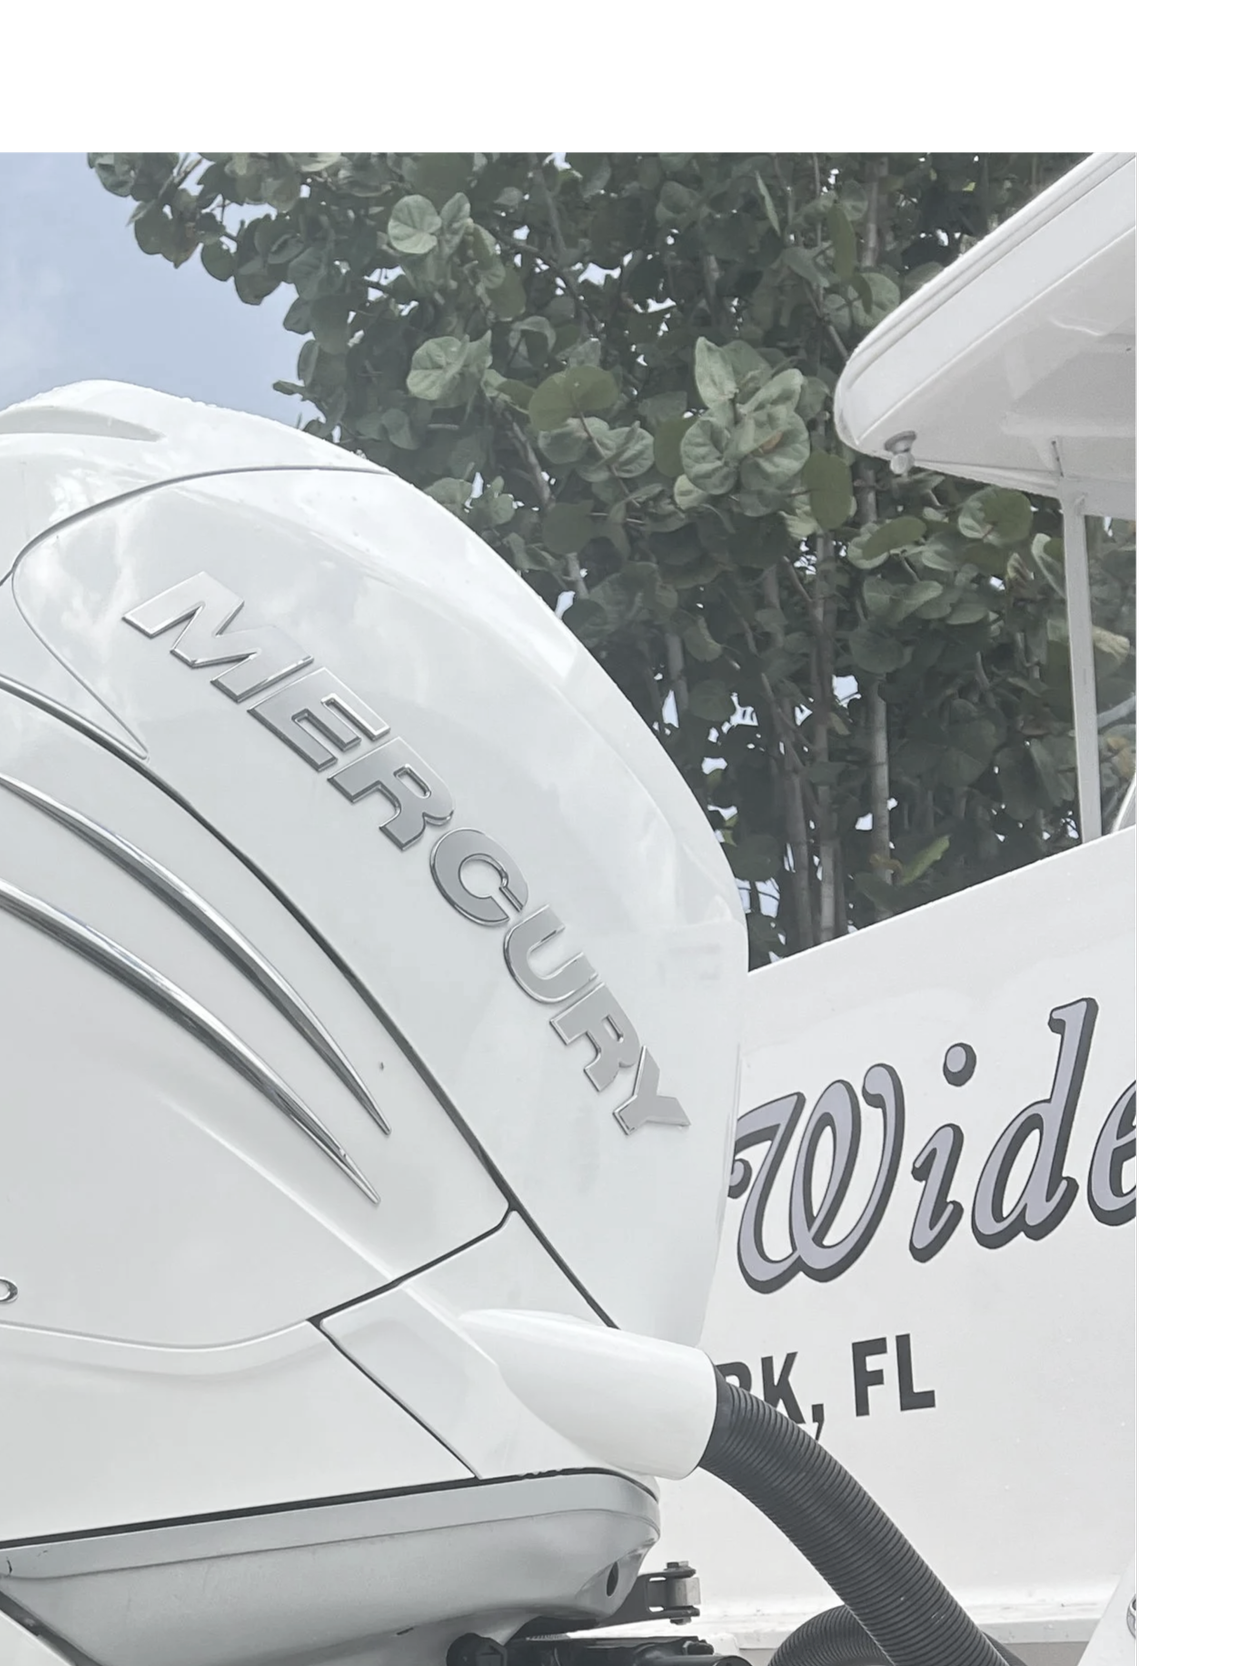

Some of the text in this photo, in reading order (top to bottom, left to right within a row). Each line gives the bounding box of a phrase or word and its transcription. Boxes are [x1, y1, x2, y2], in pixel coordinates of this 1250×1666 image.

[122, 571, 690, 1135] MERCURY
[727, 997, 1137, 1294] Wide
[851, 1333, 936, 1417] FL
